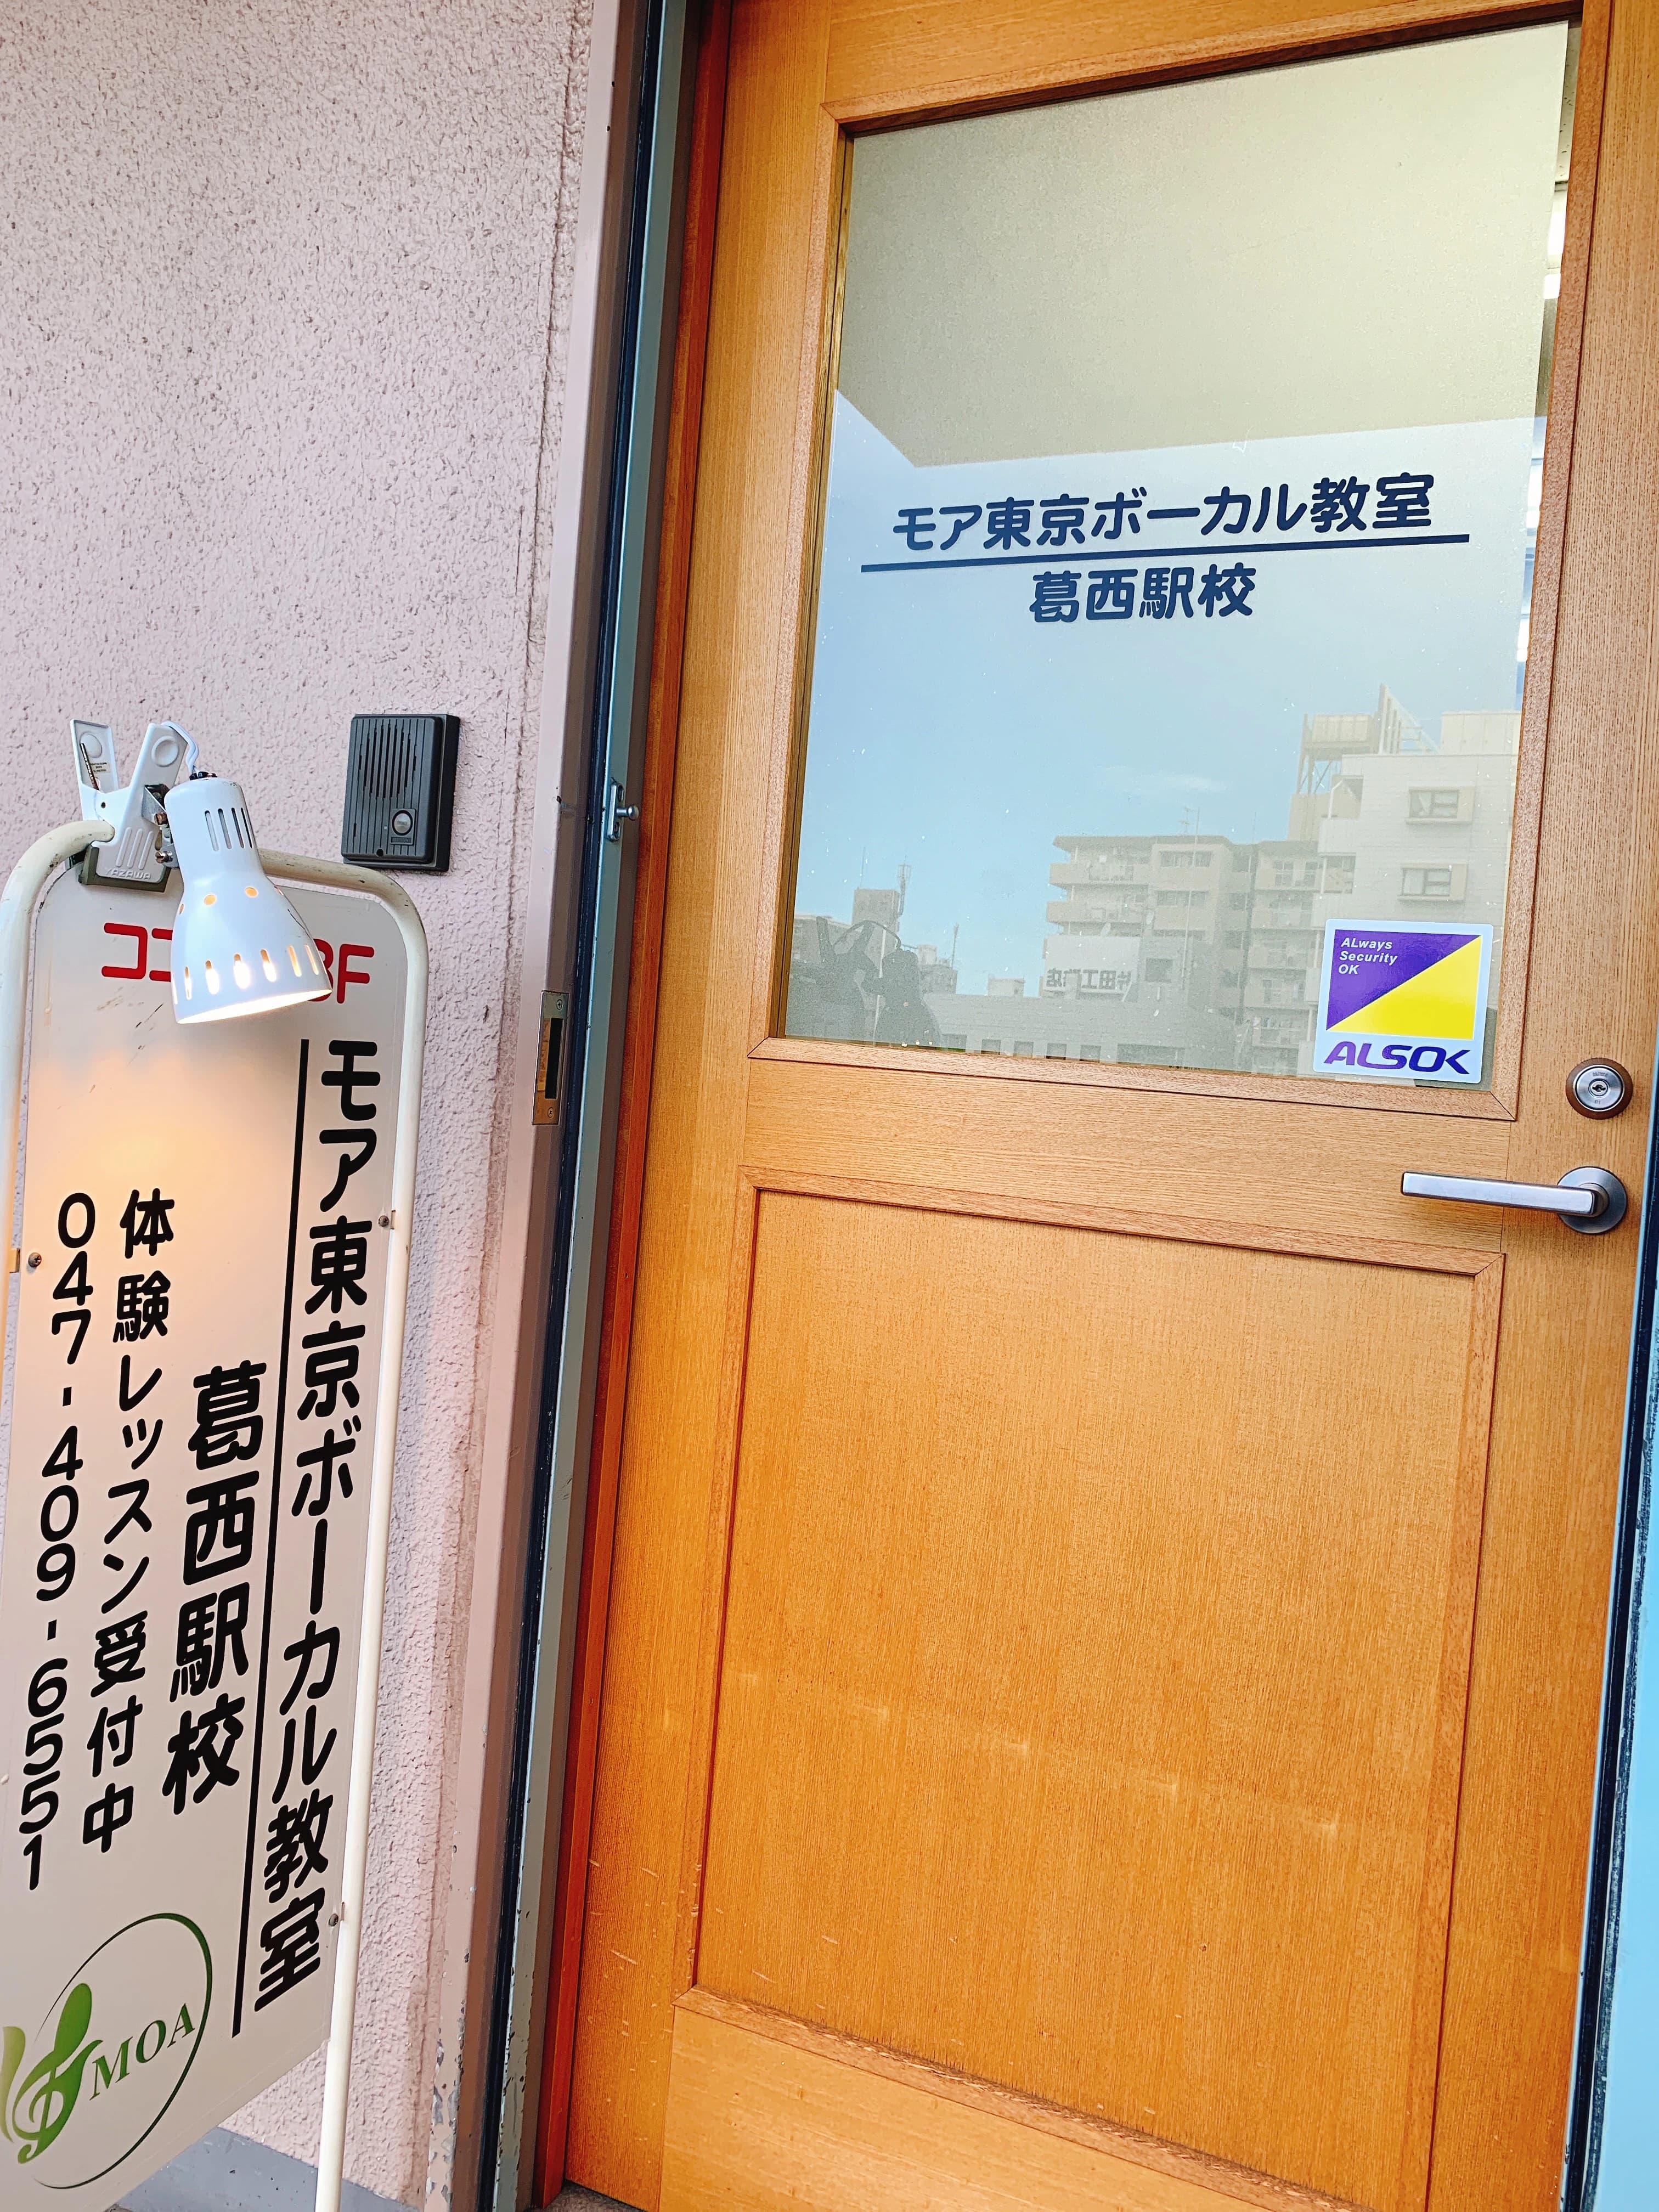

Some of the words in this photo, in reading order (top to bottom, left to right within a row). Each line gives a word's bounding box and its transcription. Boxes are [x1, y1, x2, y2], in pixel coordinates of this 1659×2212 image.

[893, 472, 1434, 550] モア東京ボーカル教室
[1029, 562, 1256, 623] 葛西駅校
[1338, 964, 1359, 975] OK
[1339, 951, 1398, 966] Security
[1340, 937, 1393, 952] ALways
[1323, 1041, 1471, 1075] ALSOK
[19, 1193, 95, 1891] 047-409-6551
[82, 1188, 175, 1853] 体験レッスン受付中
[254, 1040, 381, 2012] モア東京ボーカル教室
[162, 1359, 267, 1815] 葛西駅校
[89, 2003, 195, 2101] MOA
